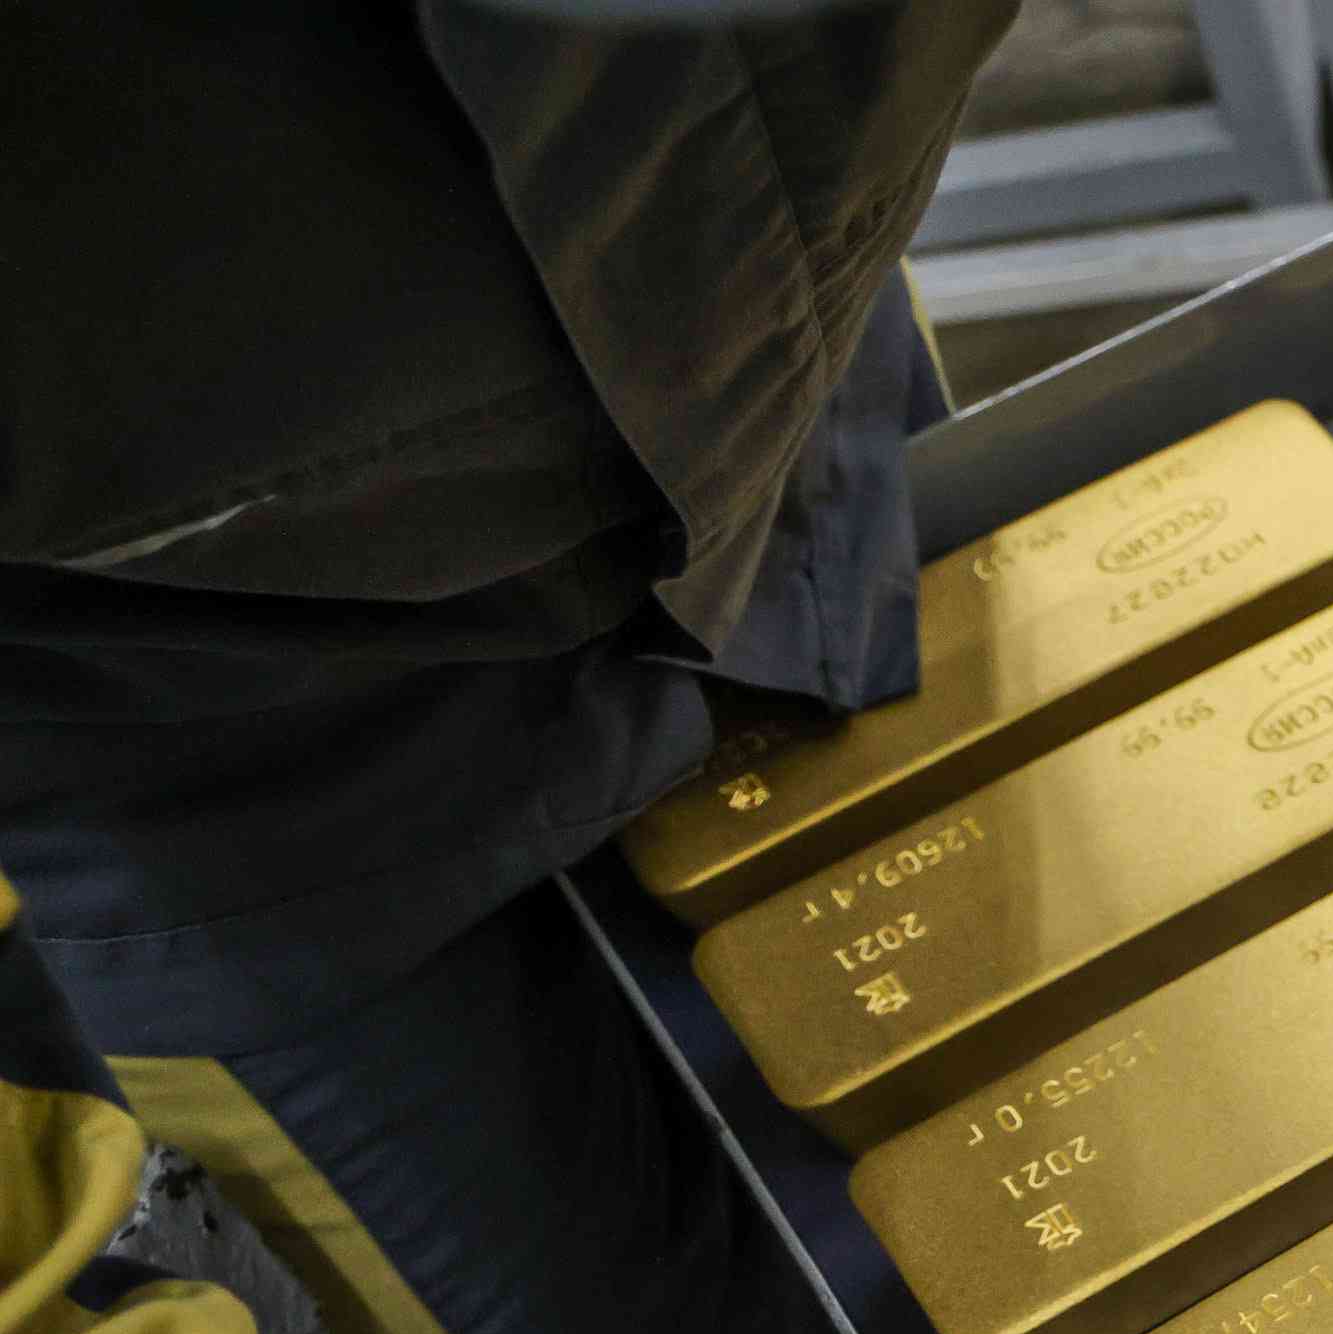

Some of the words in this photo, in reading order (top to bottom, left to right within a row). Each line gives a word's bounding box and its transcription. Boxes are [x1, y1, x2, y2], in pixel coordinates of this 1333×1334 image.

[1110, 501, 1219, 569] РОССИЯ
[831, 907, 927, 974] 2021
[998, 1131, 1099, 1204] 2021
